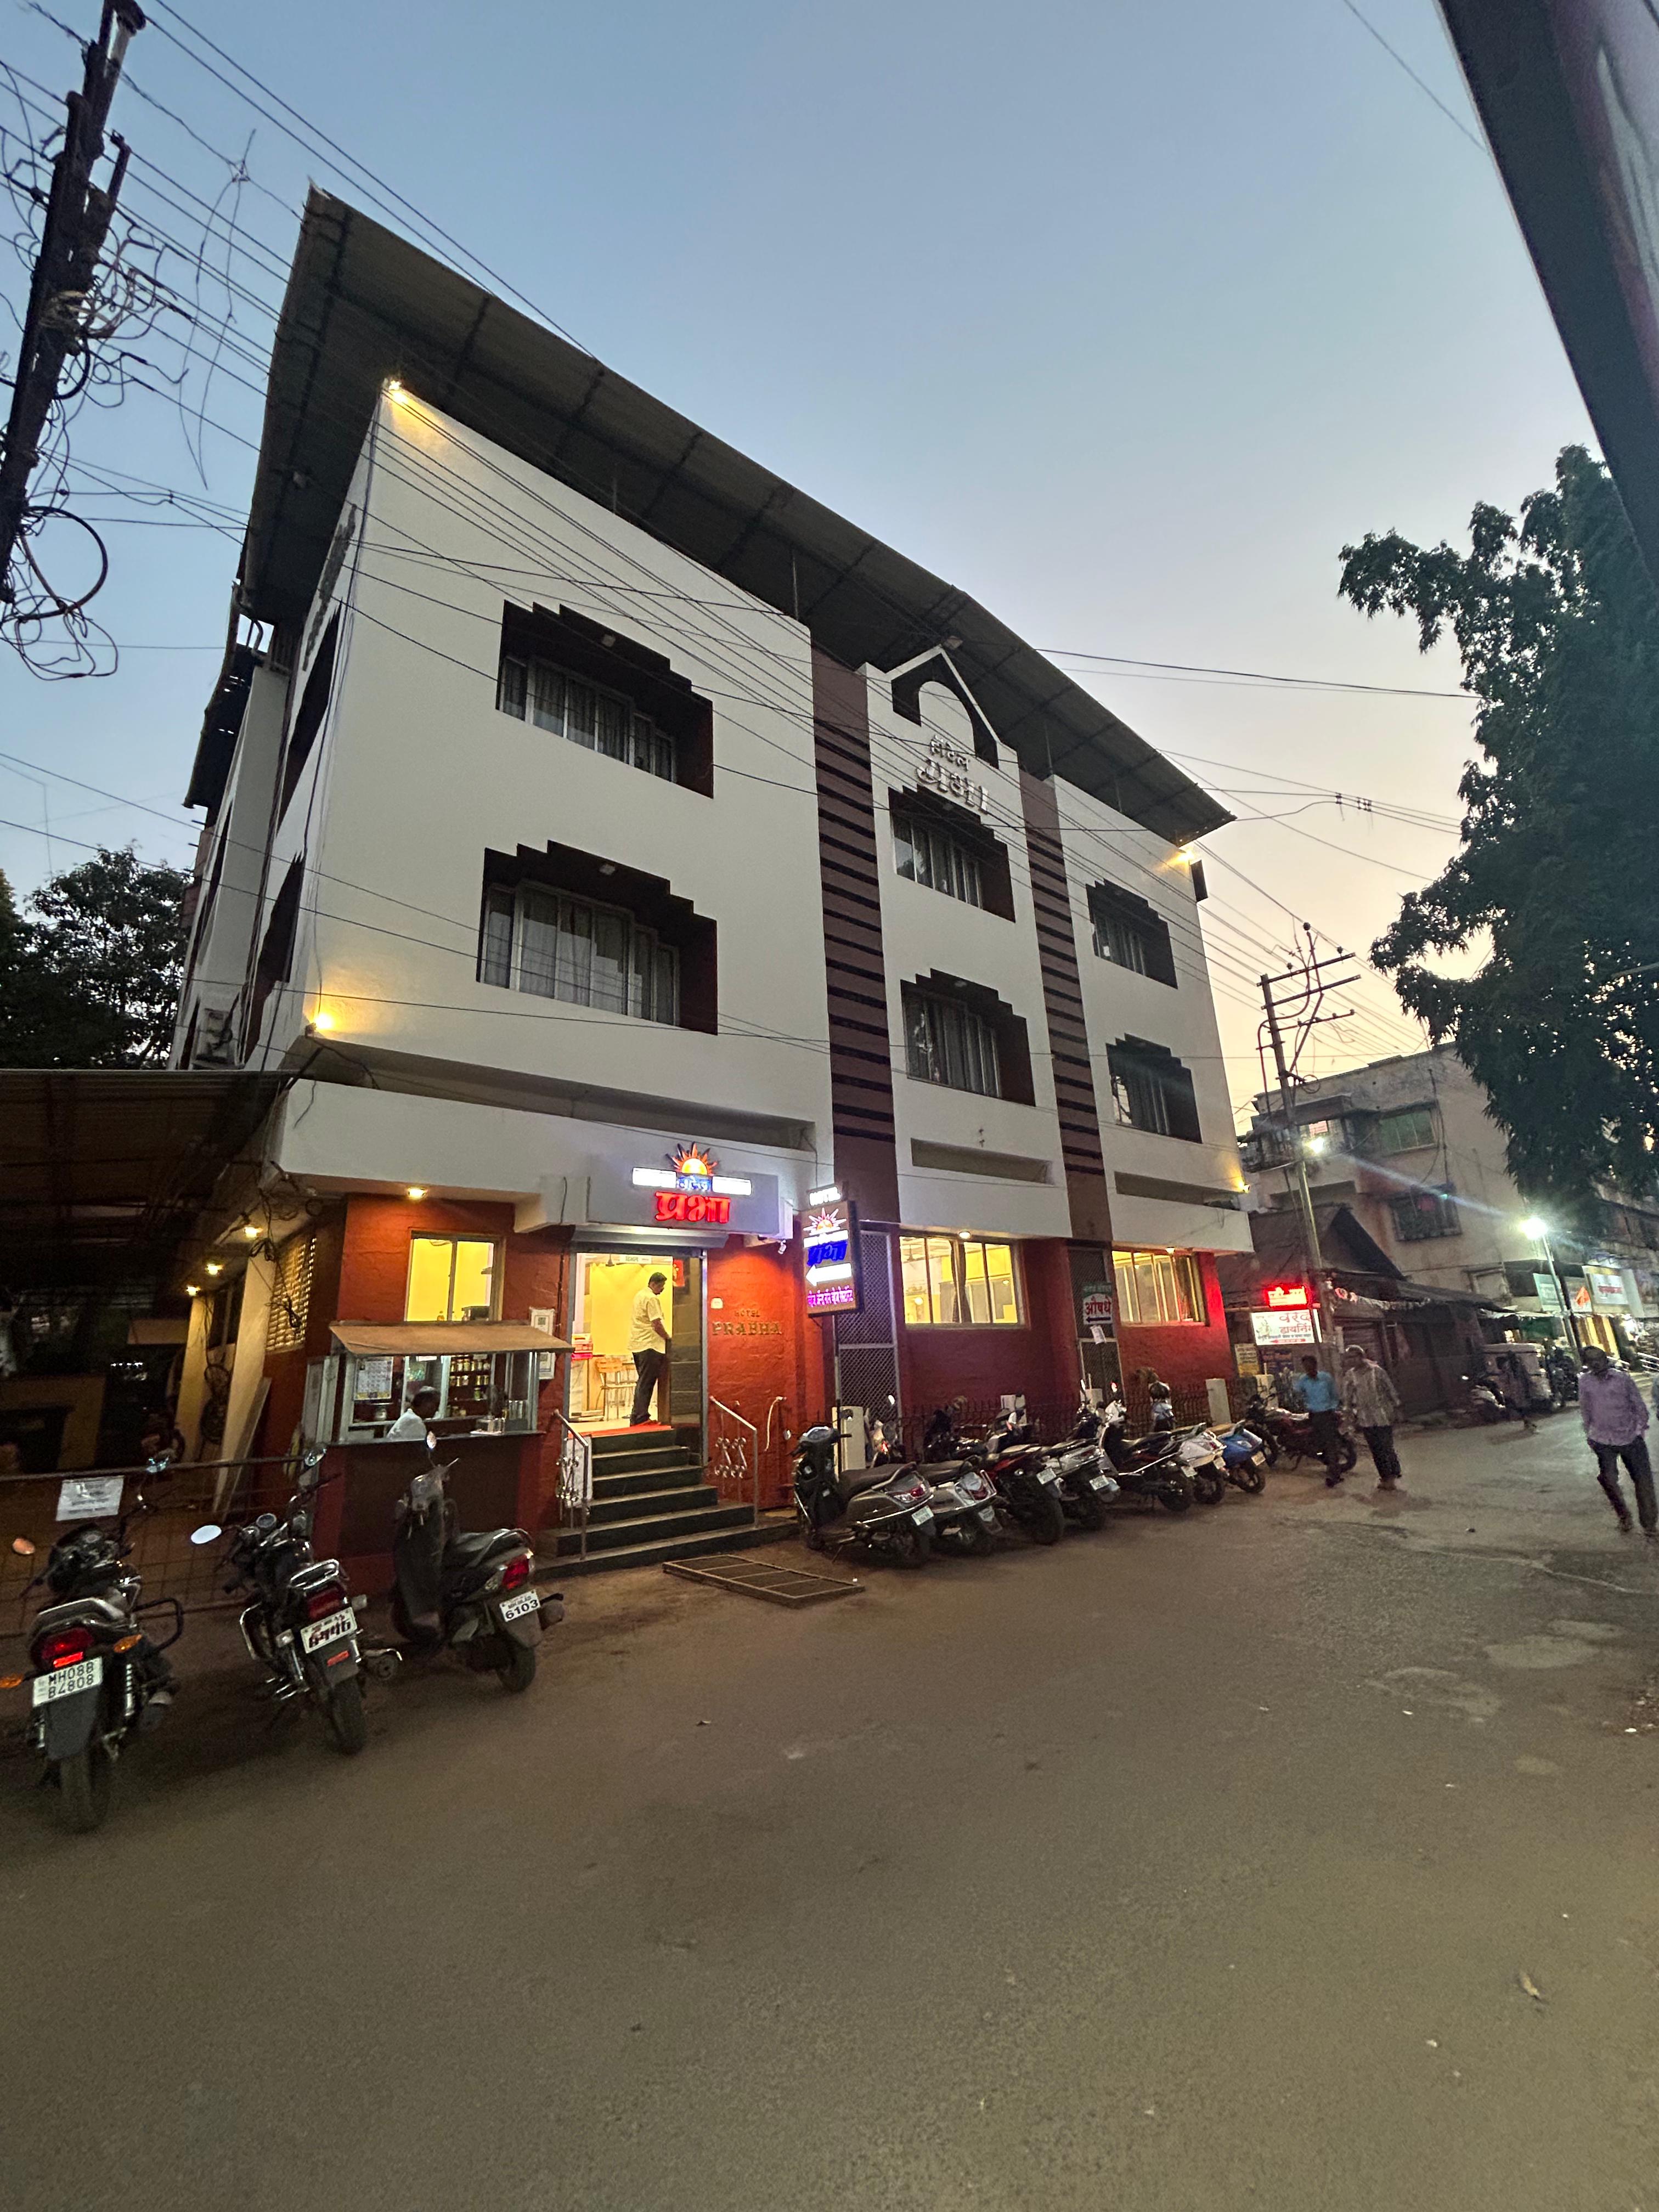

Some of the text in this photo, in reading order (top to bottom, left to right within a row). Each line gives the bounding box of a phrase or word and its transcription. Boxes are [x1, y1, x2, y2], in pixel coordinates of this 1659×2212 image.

[654, 1191, 730, 1224] प्रभा
[735, 1309, 760, 1318] HOTEL
[712, 1321, 783, 1336] PRABHA
[505, 1599, 538, 1619] 6103
